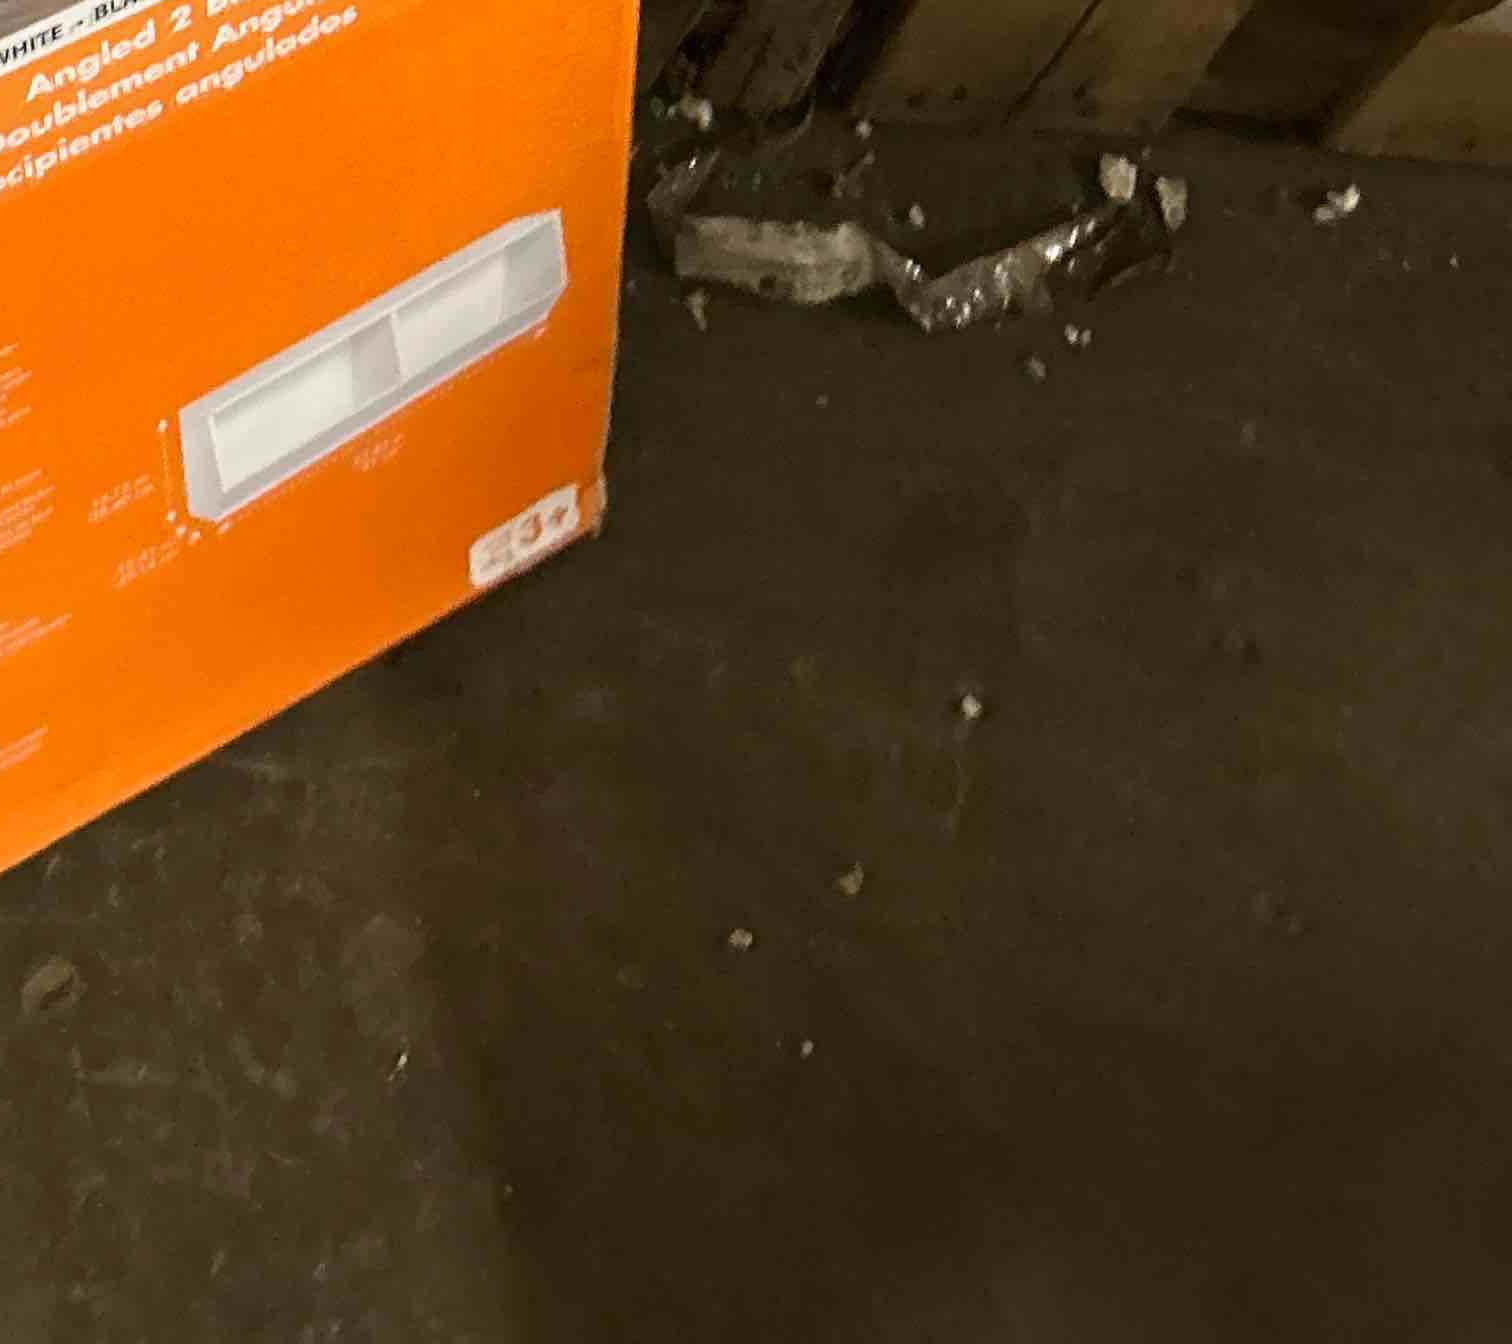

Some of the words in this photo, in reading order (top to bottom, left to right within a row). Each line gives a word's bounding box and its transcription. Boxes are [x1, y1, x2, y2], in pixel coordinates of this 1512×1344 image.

[26, 21, 156, 103] Angled
[171, 4, 192, 35] 2
[175, 6, 358, 106] angulados
